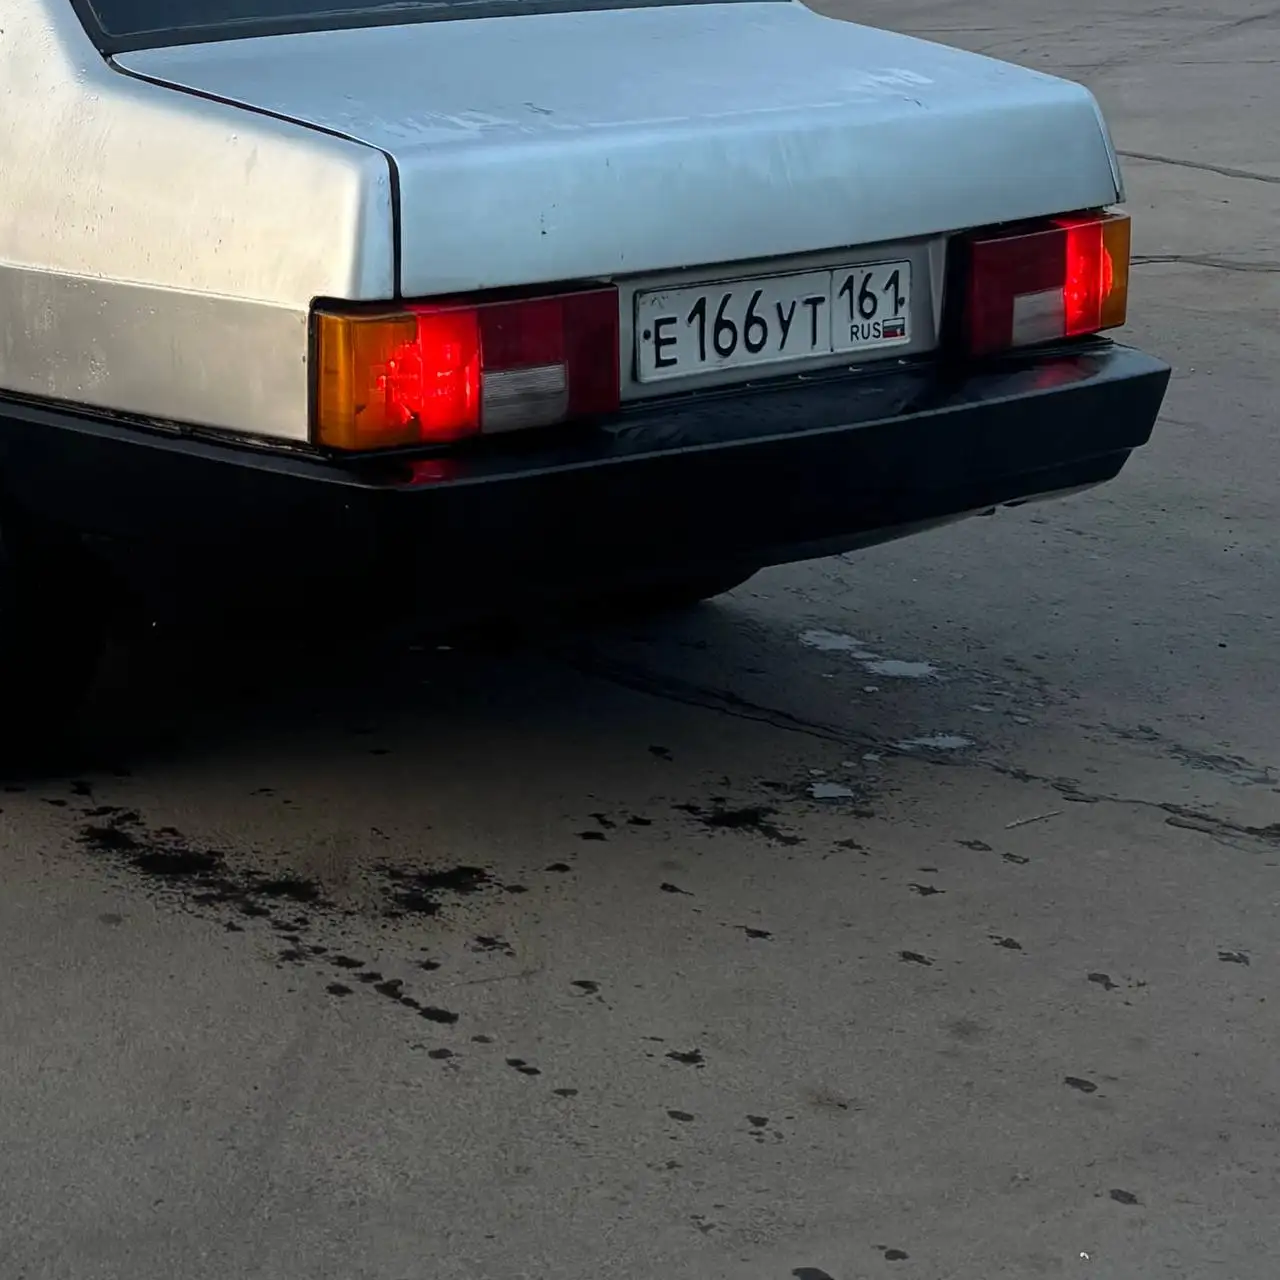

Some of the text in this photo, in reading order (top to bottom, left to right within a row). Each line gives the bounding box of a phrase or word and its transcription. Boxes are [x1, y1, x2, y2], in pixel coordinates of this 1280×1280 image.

[654, 269, 900, 369] Е166УТ 161
[850, 321, 881, 342] RUS
